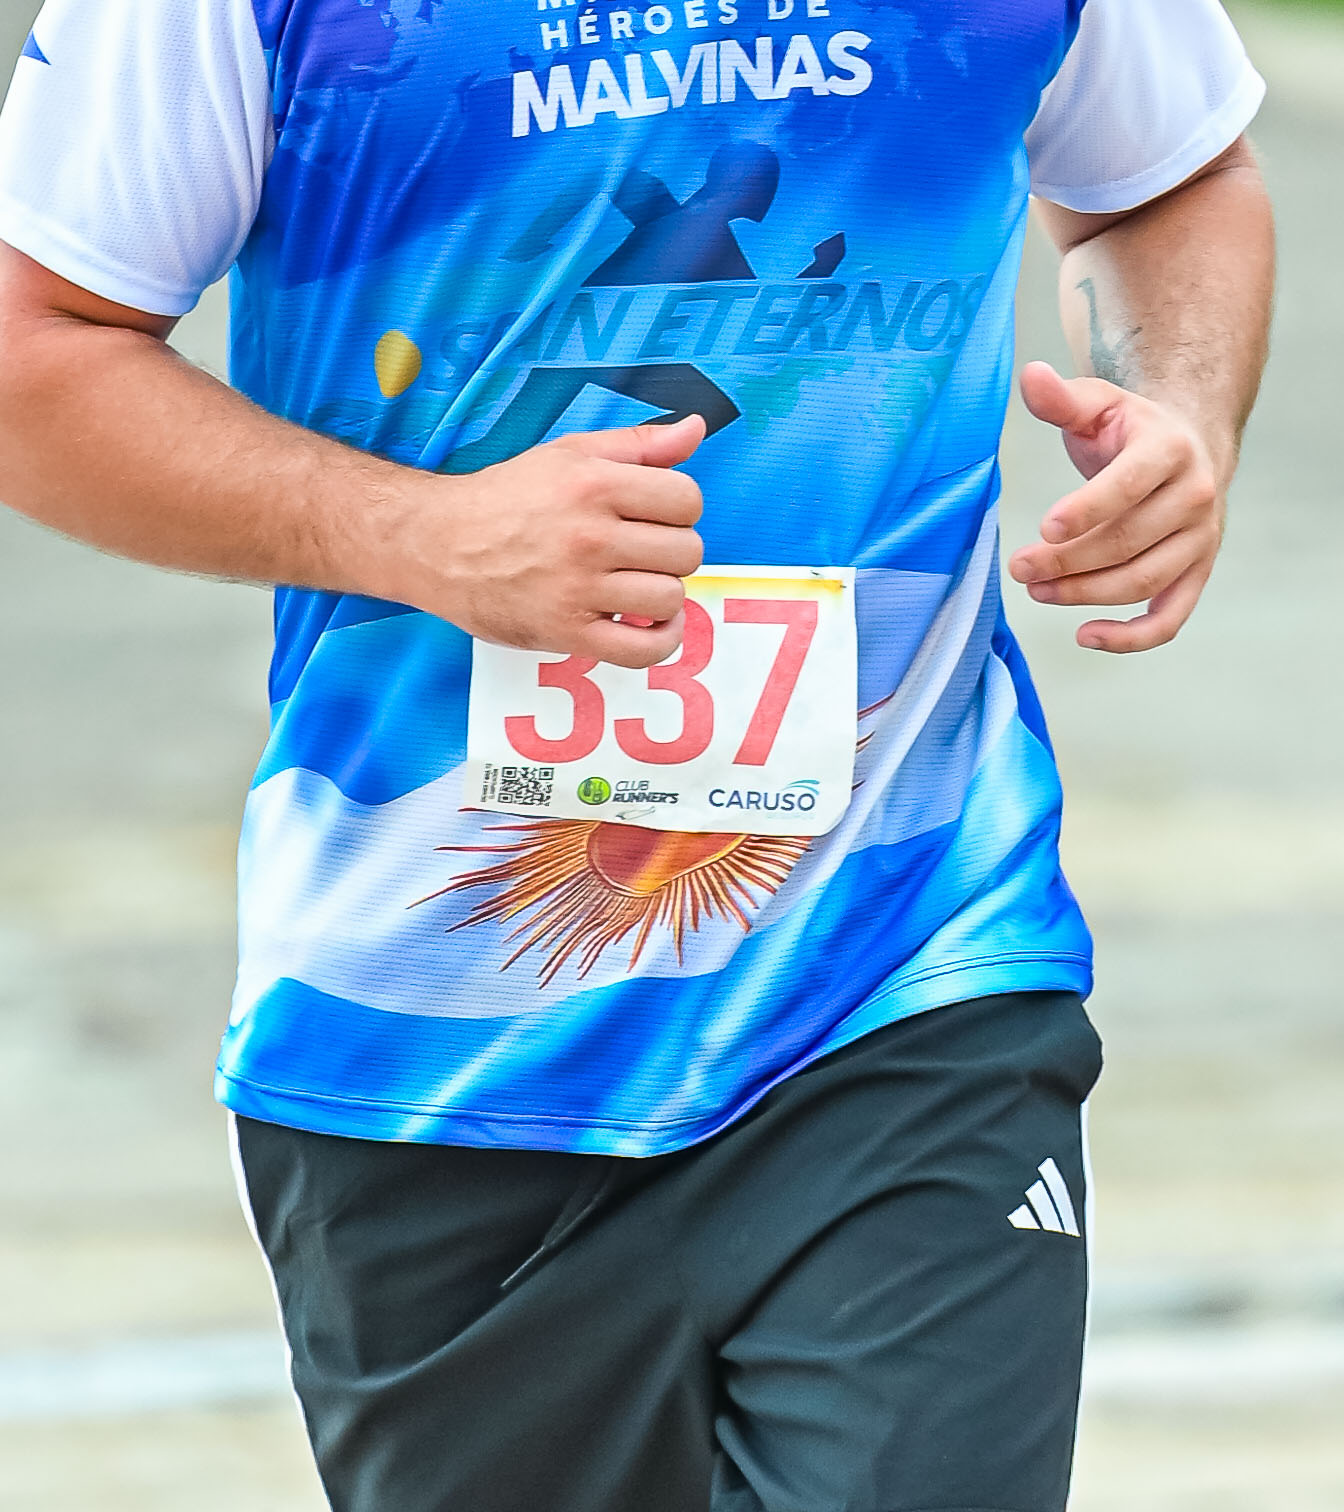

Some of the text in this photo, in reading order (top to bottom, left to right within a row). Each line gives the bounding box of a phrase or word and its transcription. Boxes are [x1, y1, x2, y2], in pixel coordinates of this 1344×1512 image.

[511, 30, 873, 138] MALVINAS
[504, 596, 819, 767] 337
[614, 780, 650, 792] CLUB
[708, 788, 816, 812] CARUSO
